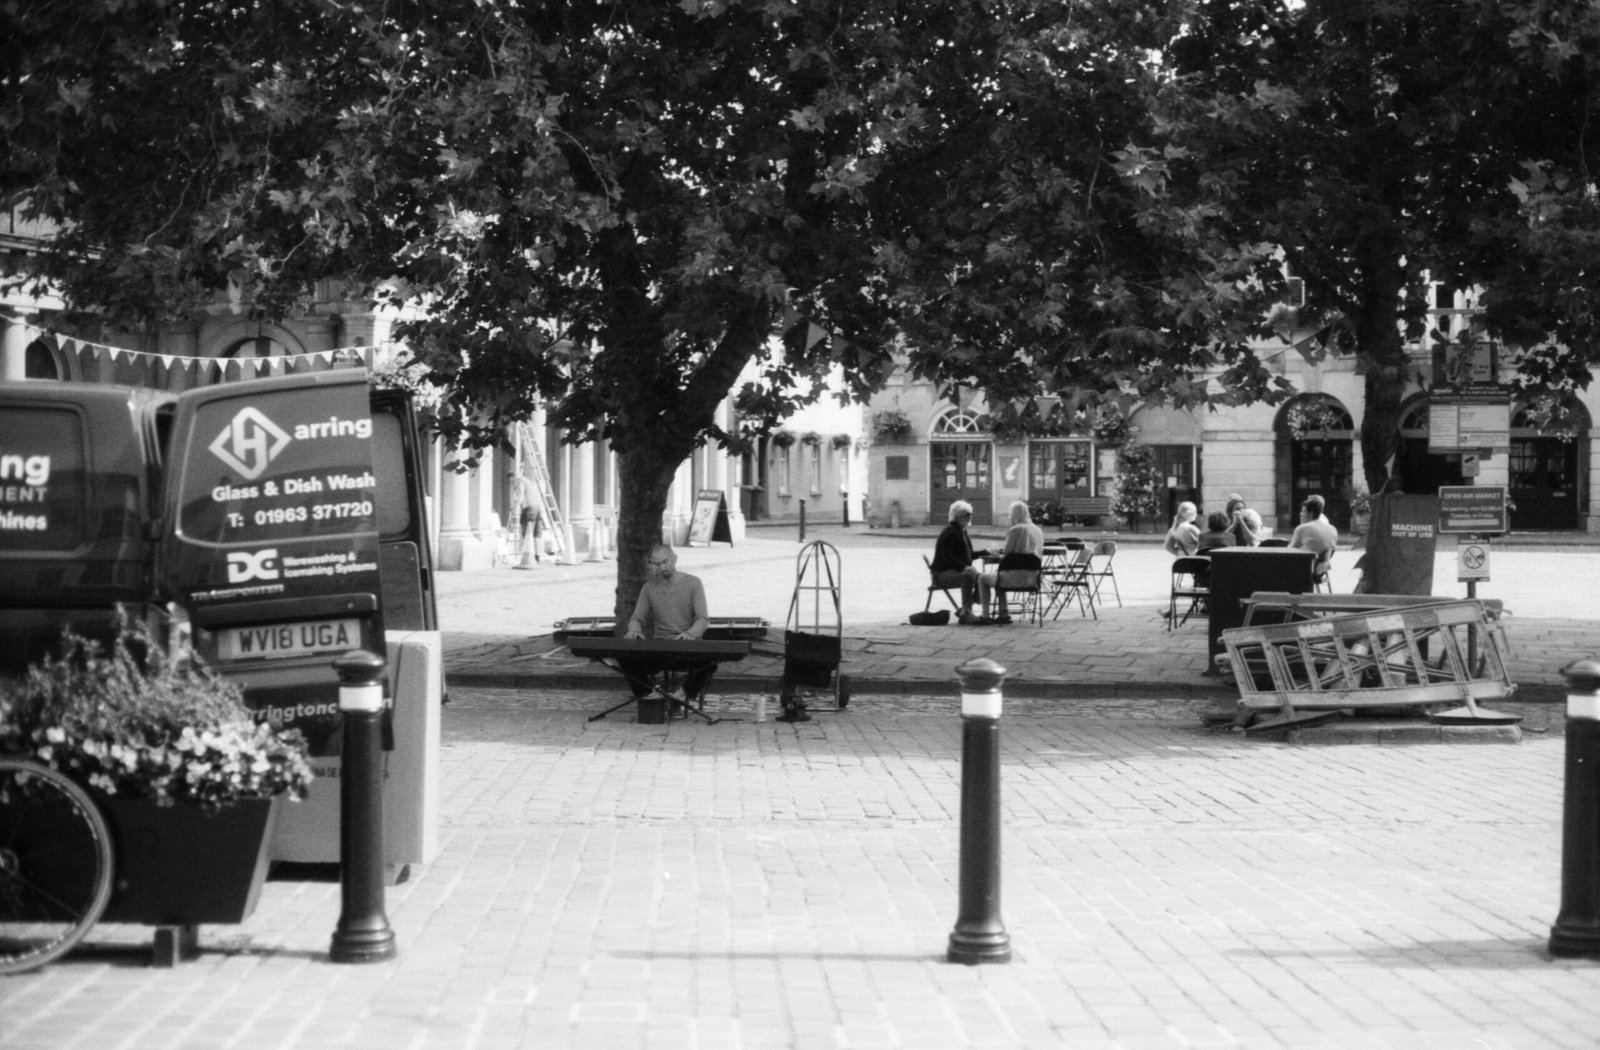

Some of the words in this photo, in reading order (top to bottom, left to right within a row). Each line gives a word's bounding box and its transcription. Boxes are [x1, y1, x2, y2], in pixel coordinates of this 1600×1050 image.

[294, 416, 372, 439] arring
[212, 485, 259, 502] Glass
[264, 481, 279, 496] &
[284, 476, 323, 494] Dish
[327, 472, 376, 490] Wash
[227, 512, 244, 528] T:
[254, 507, 308, 526] 01963
[312, 501, 373, 520] 371720
[335, 562, 377, 574] Systems
[239, 627, 295, 653] WV18
[301, 623, 350, 648] UGA
